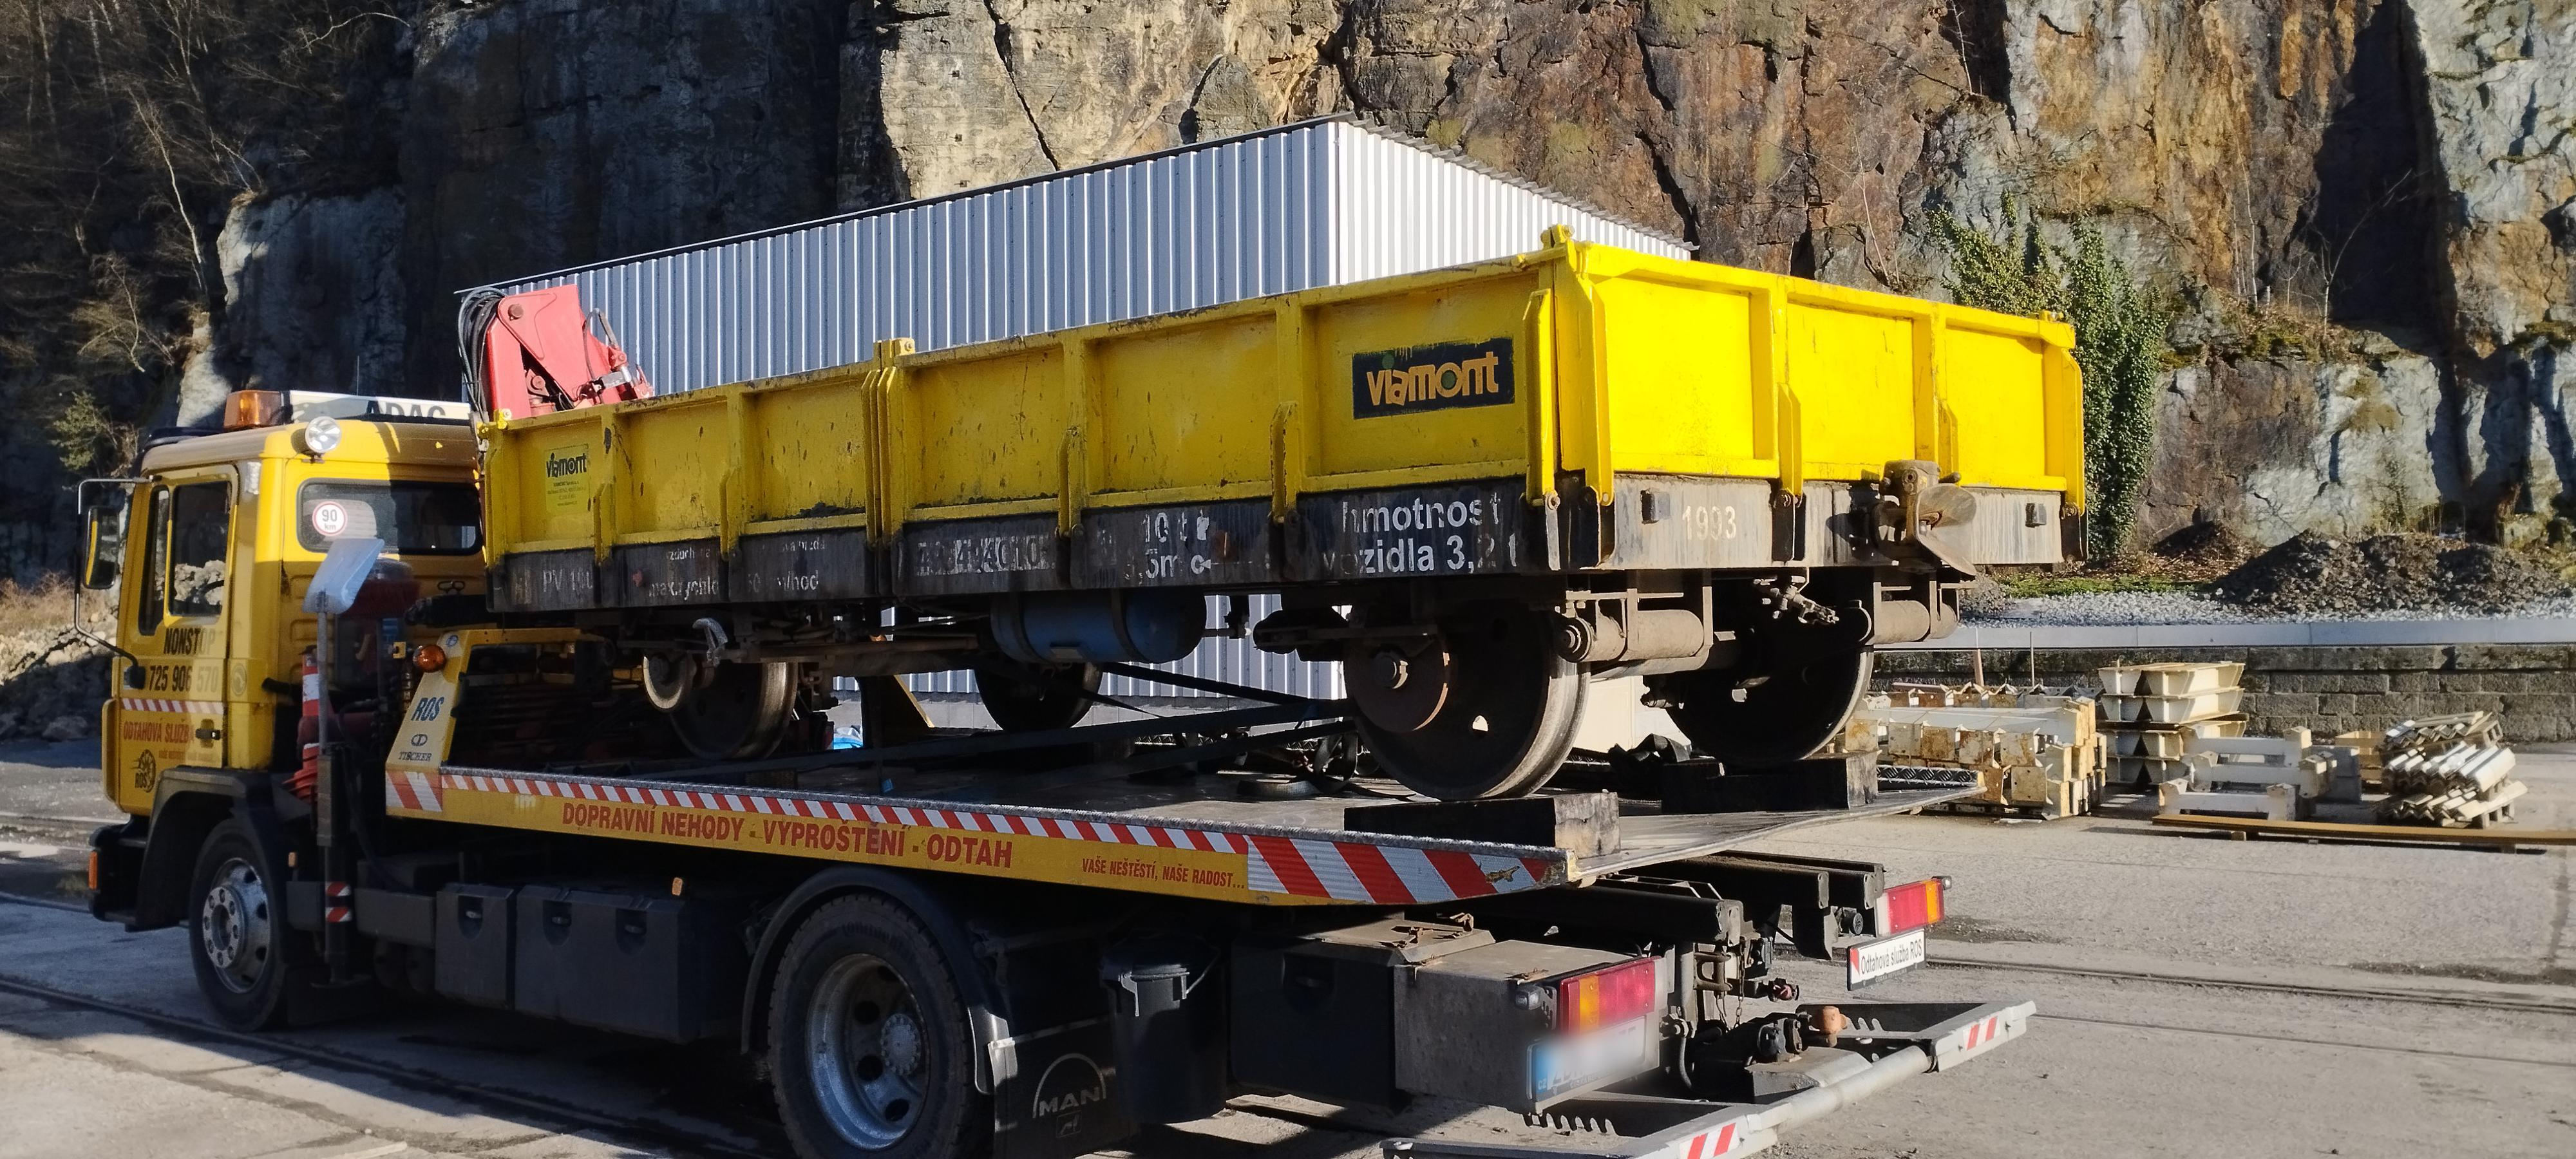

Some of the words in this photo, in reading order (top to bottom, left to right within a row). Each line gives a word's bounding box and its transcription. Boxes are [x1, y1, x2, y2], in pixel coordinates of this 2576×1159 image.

[1366, 351, 1500, 407] viamont
[546, 453, 587, 478] viamont
[321, 509, 337, 522] 90
[164, 627, 216, 655] NONSTOP
[149, 664, 168, 692] 725
[172, 665, 193, 692] 906
[196, 666, 220, 693] 570
[411, 696, 444, 722] ROS
[399, 751, 432, 761] TISCHER
[562, 802, 656, 834] DOPRAVNÍ
[661, 811, 744, 842] NEHODY
[763, 819, 907, 856] VYPROŠTĚNÍ
[927, 834, 1012, 868] ODTAH
[1082, 855, 1106, 874] VAŠE
[1110, 858, 1158, 882] NEŠTĚSTÍ,
[1162, 863, 1189, 883] NAŠE
[1191, 869, 1245, 889] RADOST...
[1861, 947, 1889, 975] Odtahová
[1890, 943, 1909, 966] služba
[1909, 938, 1922, 960] ROS
[1039, 1086, 1101, 1117] MAN
